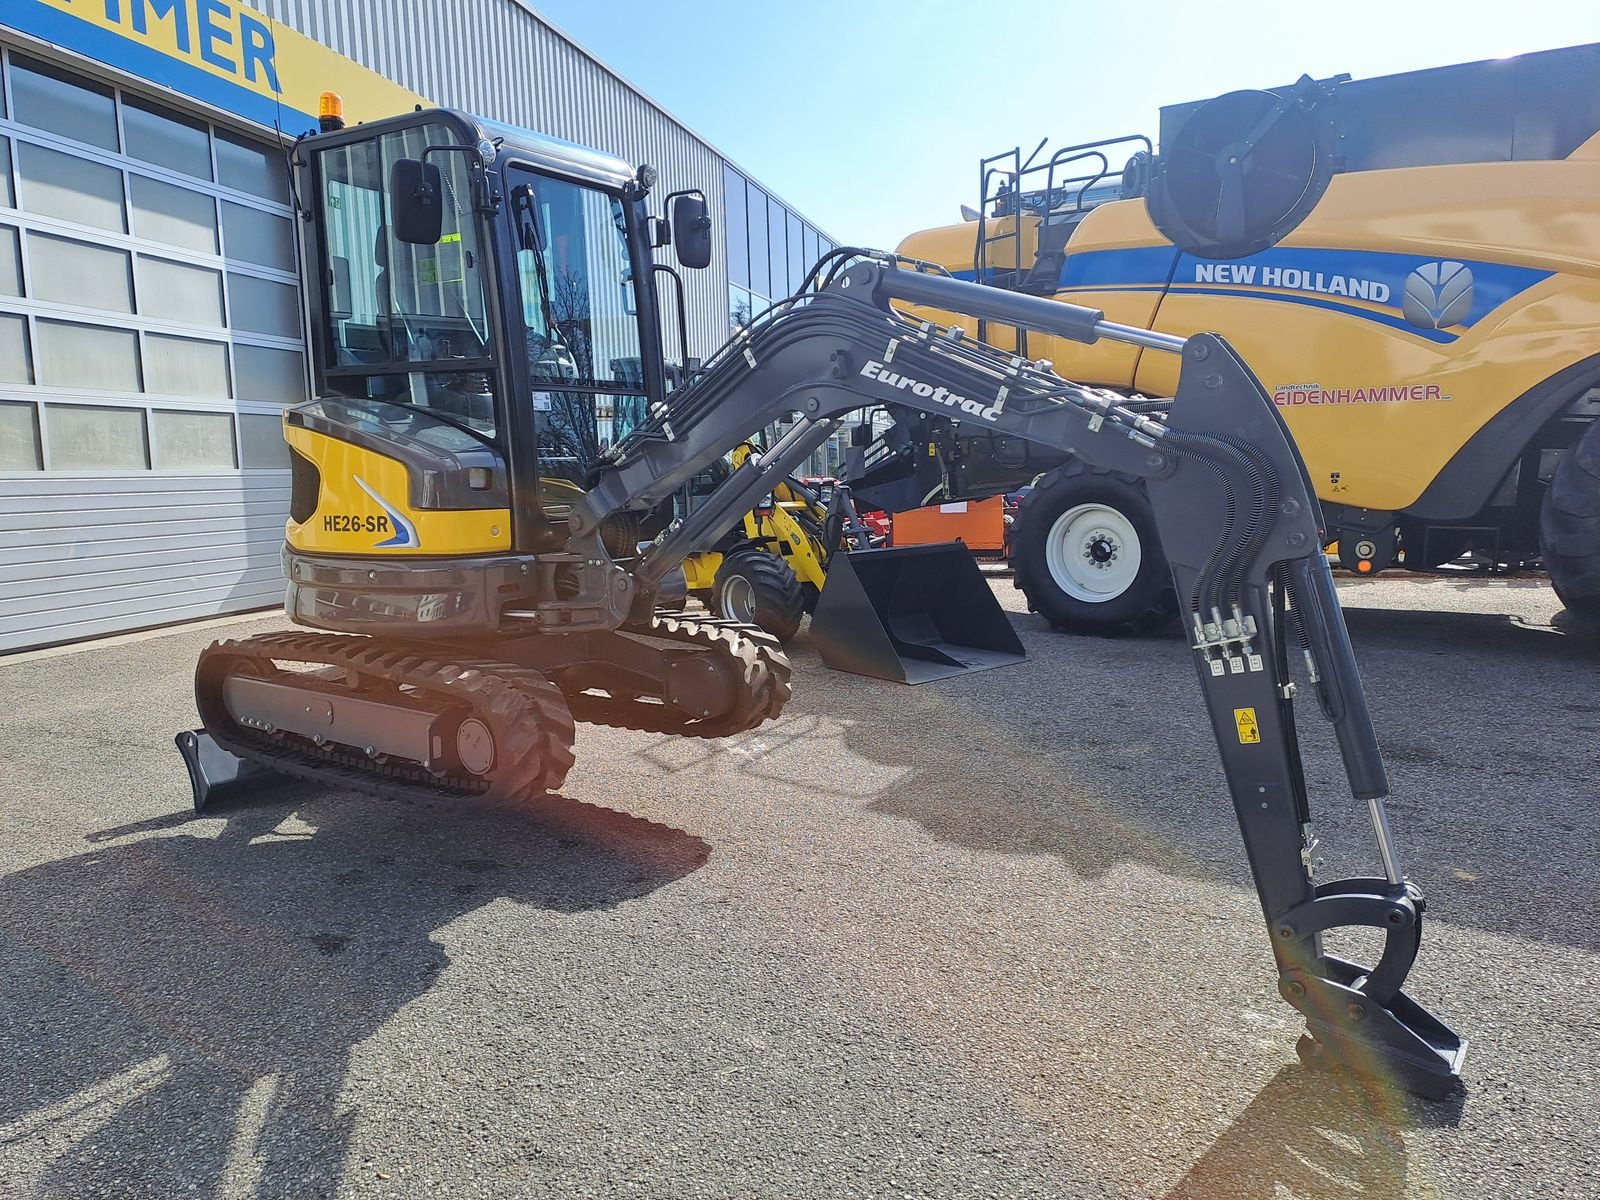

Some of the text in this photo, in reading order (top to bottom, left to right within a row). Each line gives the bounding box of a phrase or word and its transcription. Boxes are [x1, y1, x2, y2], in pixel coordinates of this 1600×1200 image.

[62, 0, 283, 94] MER
[1195, 264, 1390, 303] NEW HOLLAND
[860, 360, 1004, 422] Eurotrac
[1273, 385, 1440, 406] EIDENHAMMER
[1274, 383, 1320, 391] Landtechnik
[323, 515, 388, 533] HE26-SR
